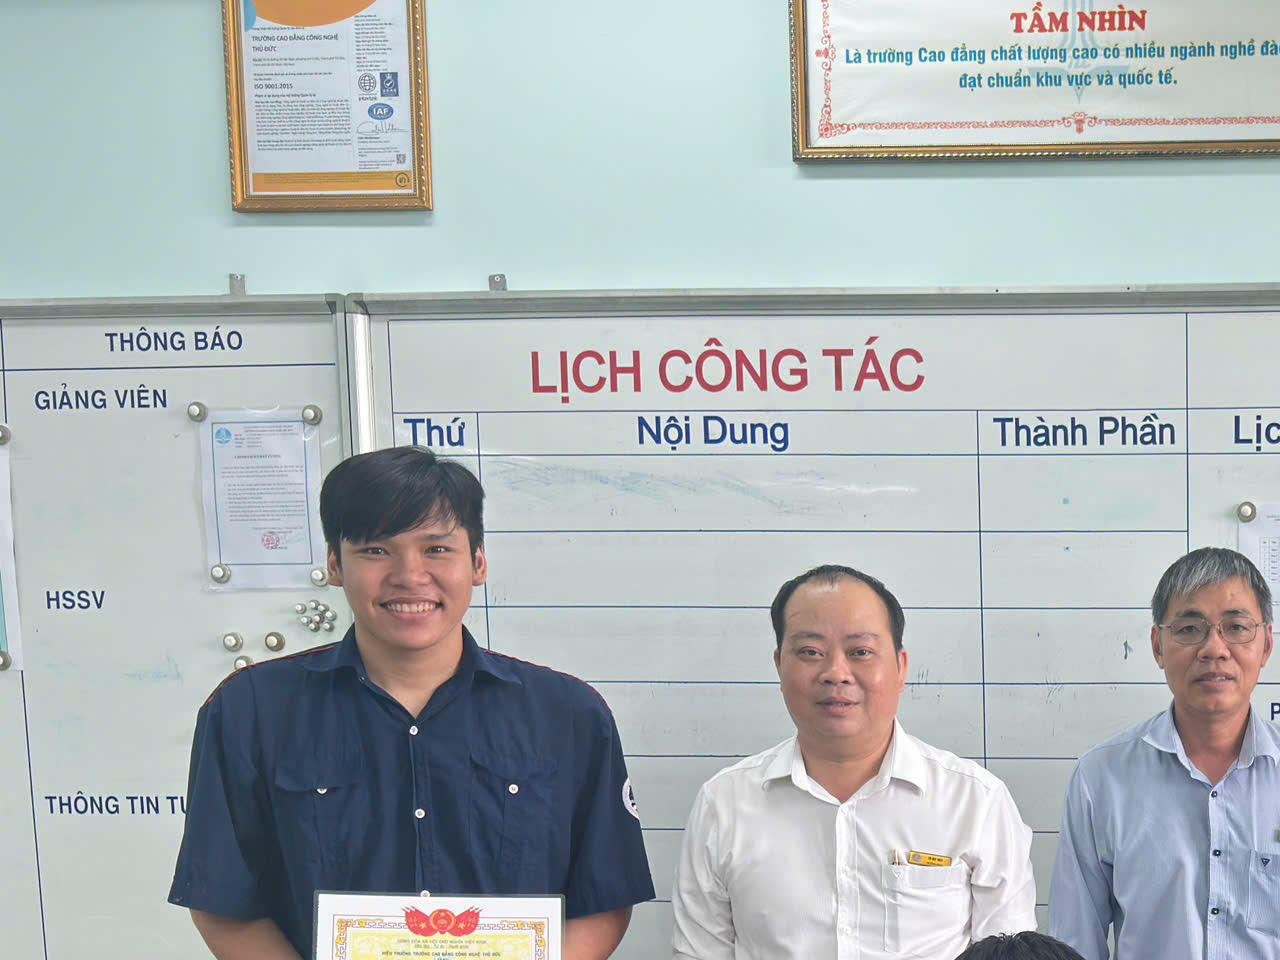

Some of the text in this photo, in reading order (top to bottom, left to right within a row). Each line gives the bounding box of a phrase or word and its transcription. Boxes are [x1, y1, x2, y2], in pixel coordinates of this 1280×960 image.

[1010, 2, 1147, 33] TẦM NHÌN
[846, 49, 862, 64] Là
[867, 48, 912, 65] trường
[918, 47, 946, 63] Cao
[950, 43, 986, 64] đẳng
[991, 43, 1022, 61] chất
[1027, 45, 1067, 64] lượng
[1072, 46, 1098, 60] cao
[1103, 43, 1120, 59] có
[1125, 41, 1165, 58] nhiều
[1170, 42, 1215, 60] ngành
[1220, 39, 1255, 60] nghề
[959, 67, 1177, 91] đạt chuẩn khu vực và quốc tế.
[372, 107, 389, 115] IAF
[105, 326, 243, 352] THÔNG BÁO
[531, 336, 925, 404] LỊCH CÔNG TÁC
[34, 383, 168, 410] GIẢNG VIÊN
[403, 416, 466, 447] Thứ
[637, 415, 789, 452] Nội Dung
[993, 413, 1176, 446] Thành Phần
[46, 591, 105, 609] HSSV
[45, 791, 120, 814] THÔNG
[126, 796, 159, 814] TIN
